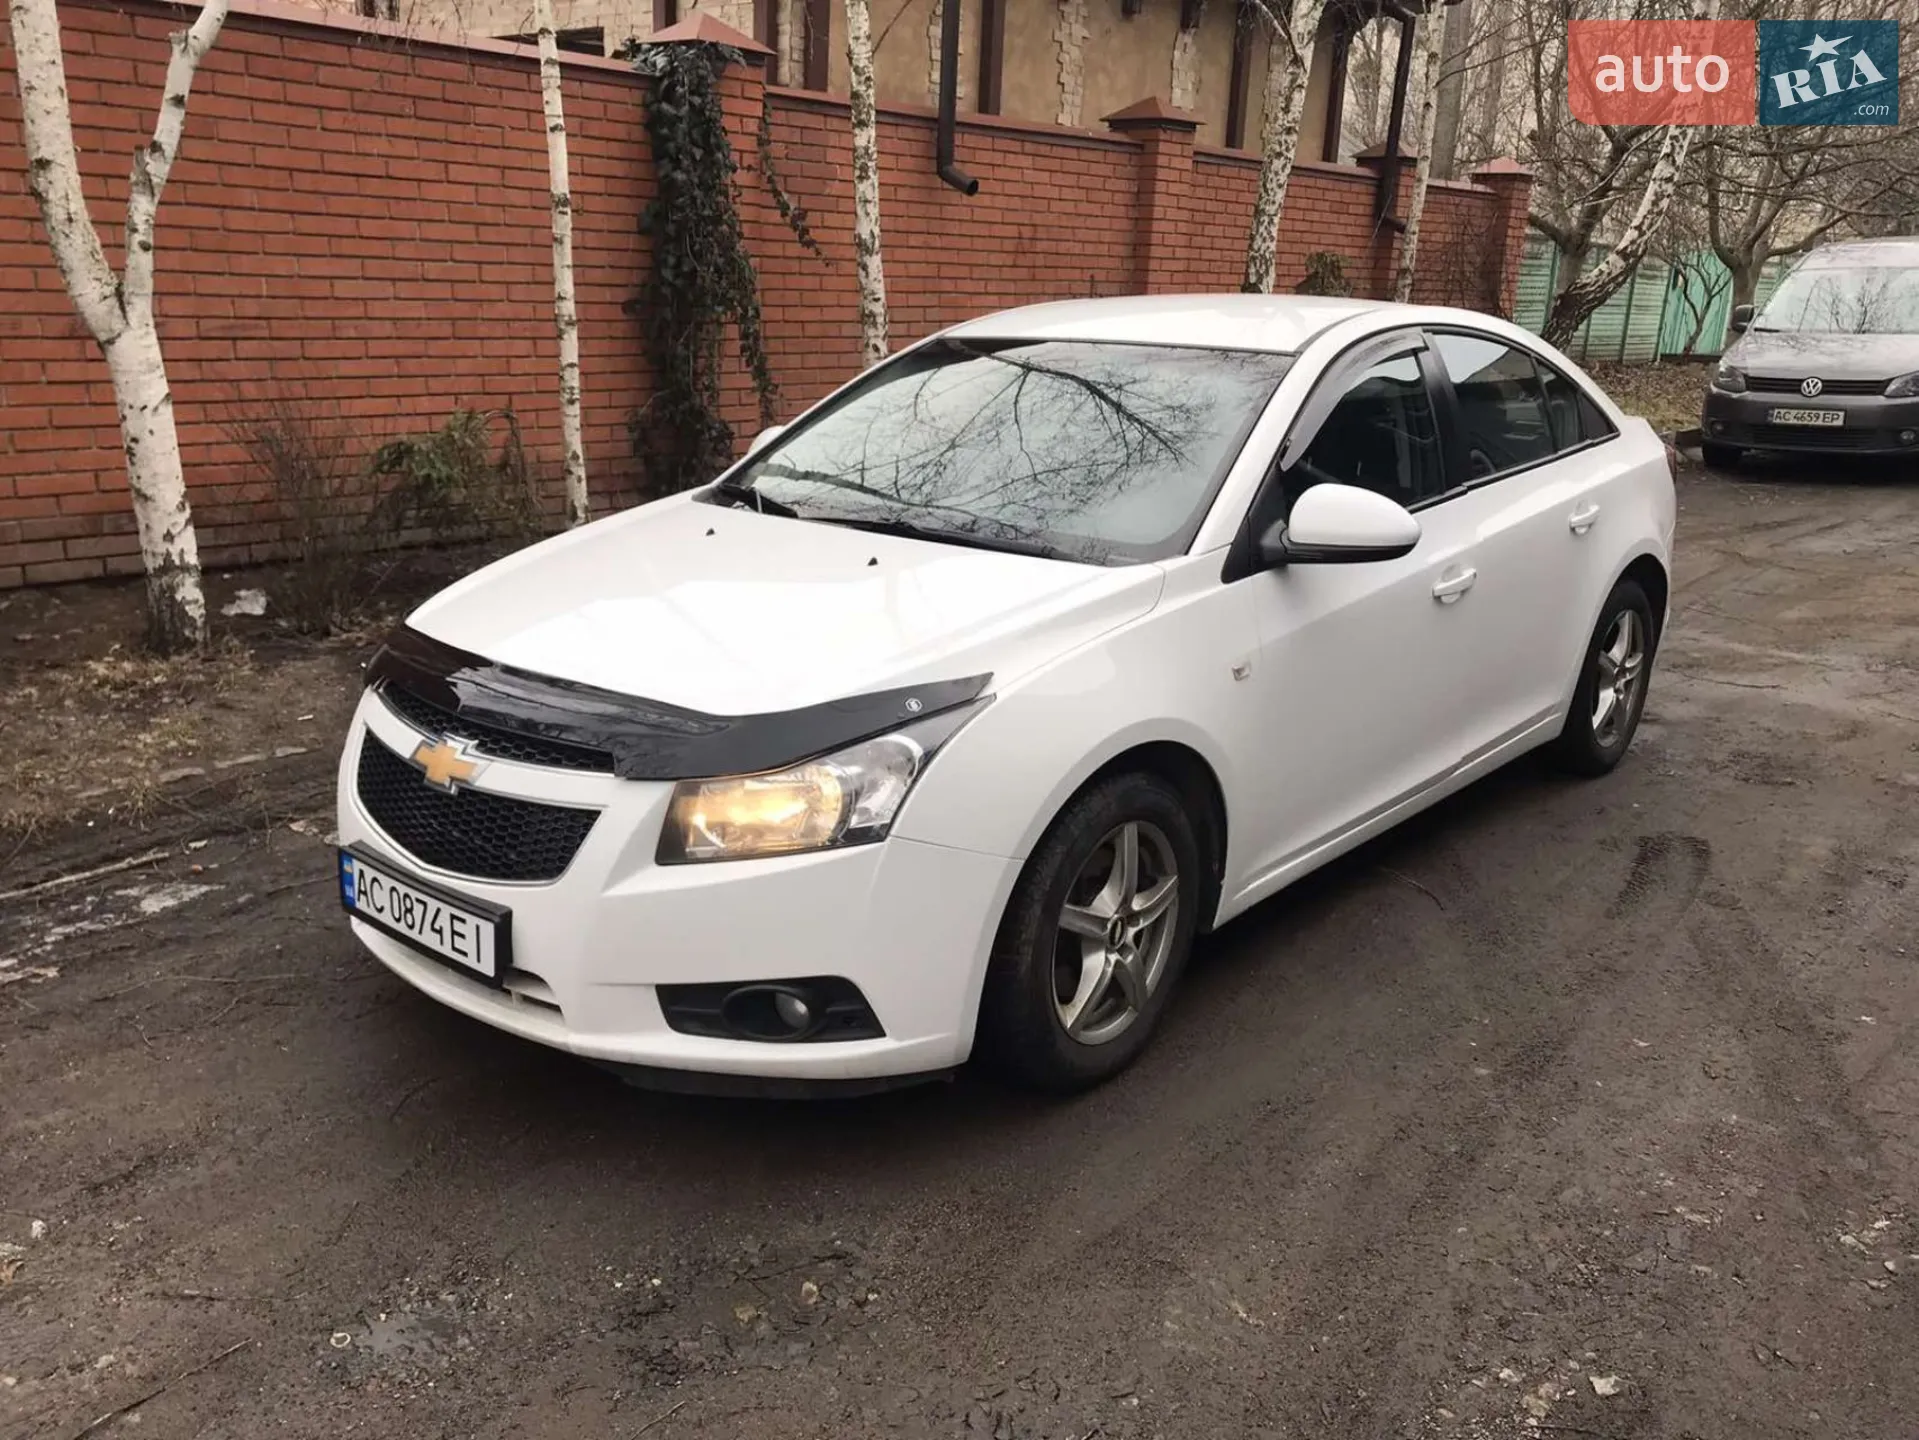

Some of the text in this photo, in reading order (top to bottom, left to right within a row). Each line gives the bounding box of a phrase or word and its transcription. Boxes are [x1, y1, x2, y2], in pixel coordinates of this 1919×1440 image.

[1774, 411, 1841, 424] AC 4659 EP
[357, 868, 385, 914] AC
